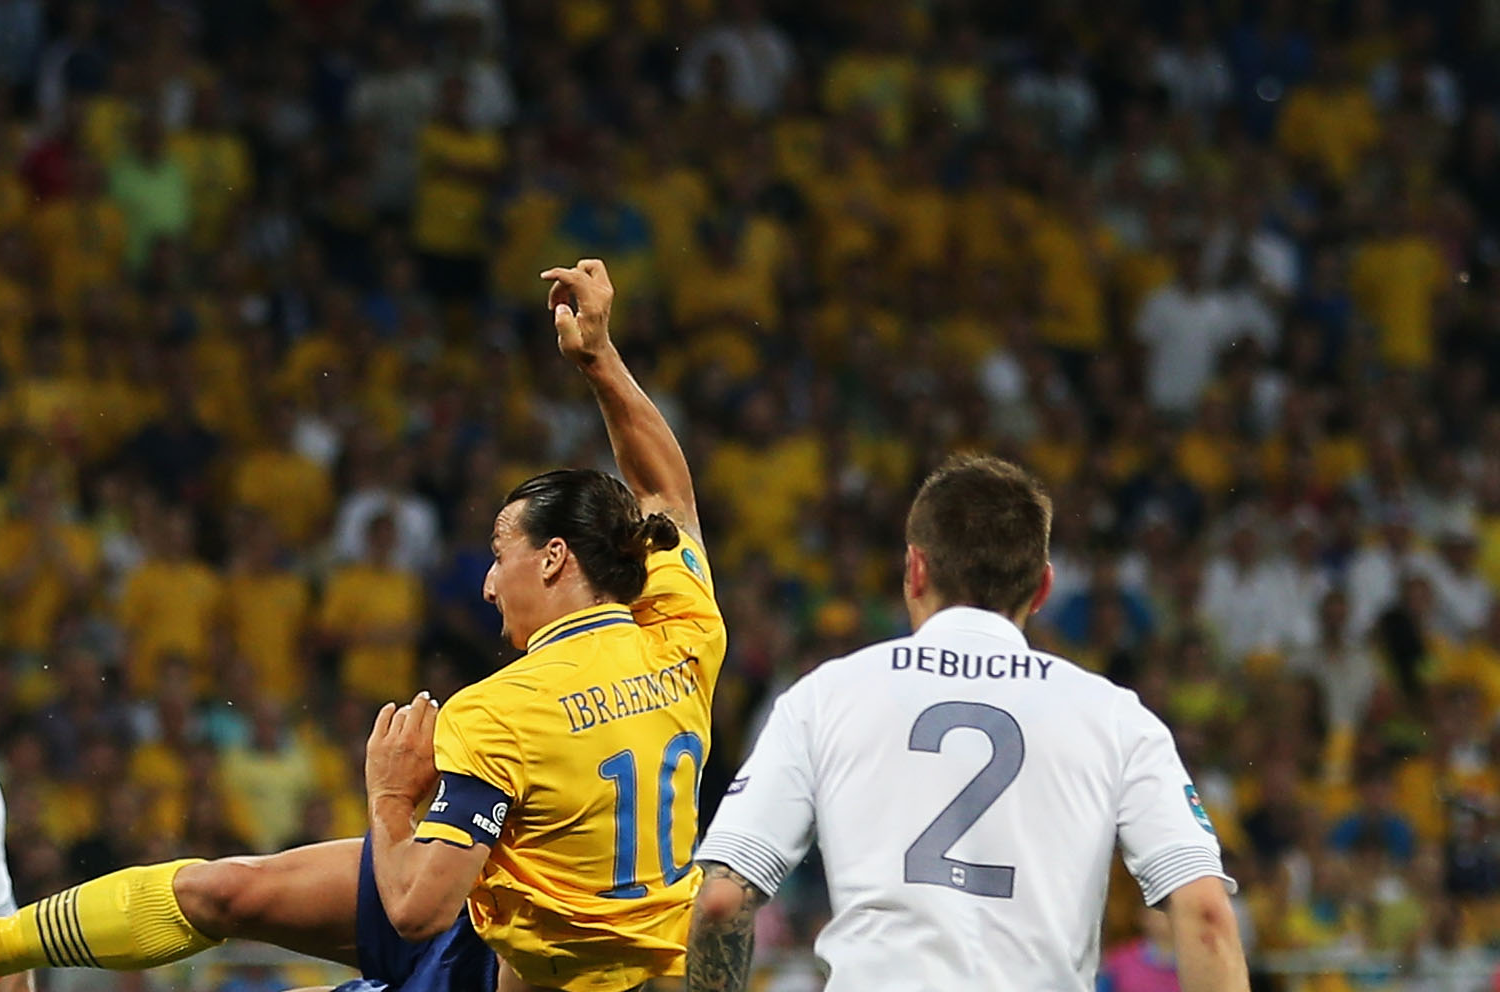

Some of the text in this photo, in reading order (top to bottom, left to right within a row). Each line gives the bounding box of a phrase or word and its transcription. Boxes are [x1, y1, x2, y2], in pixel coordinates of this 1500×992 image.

[558, 656, 699, 733] IBRAHIMOV
[891, 646, 1055, 681] DEBUCHY
[472, 813, 501, 839] RESP
[596, 731, 704, 899] 10
[903, 700, 1026, 899] 2
